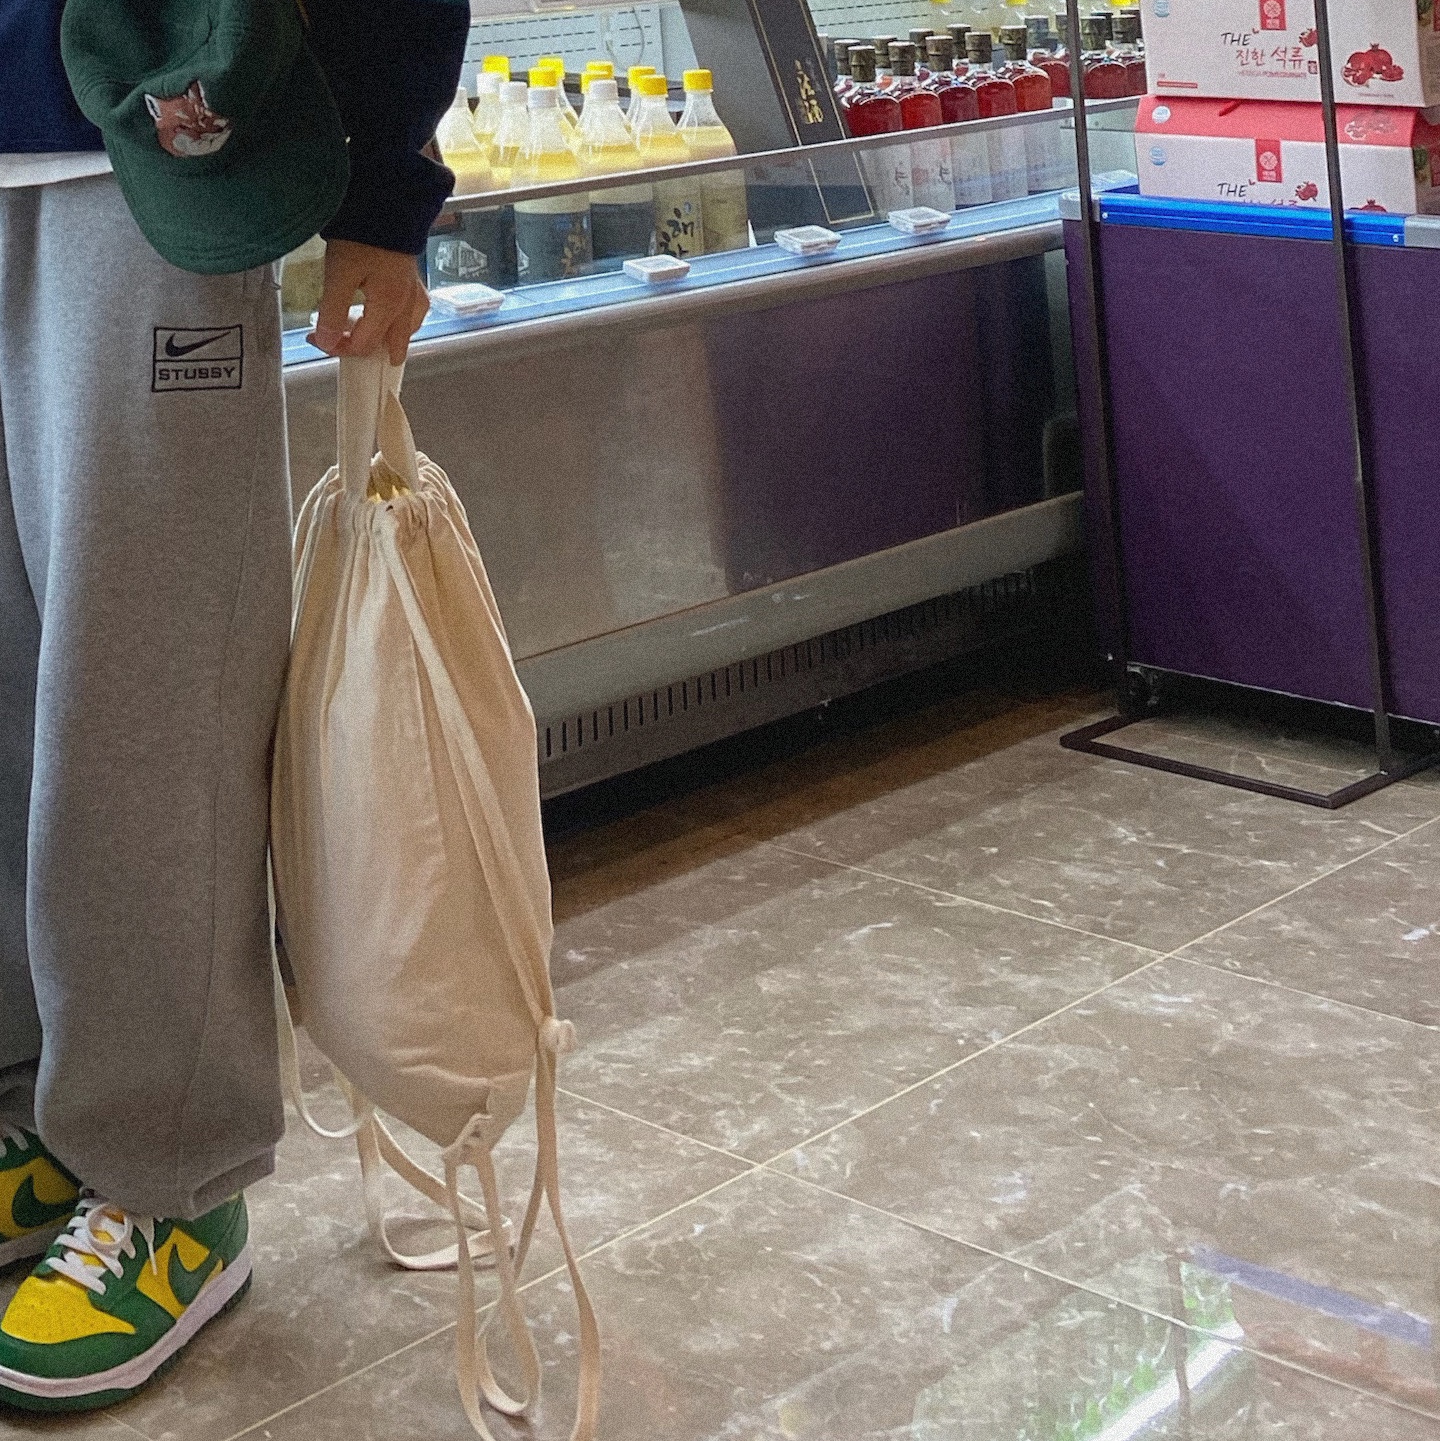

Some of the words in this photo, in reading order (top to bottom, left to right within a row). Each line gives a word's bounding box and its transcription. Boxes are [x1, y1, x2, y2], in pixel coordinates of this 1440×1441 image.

[1220, 32, 1253, 47] THE
[1235, 48, 1265, 67] 진한
[1270, 46, 1306, 69] 석류
[1217, 182, 1248, 198] THE
[158, 366, 236, 381] STUSSY
